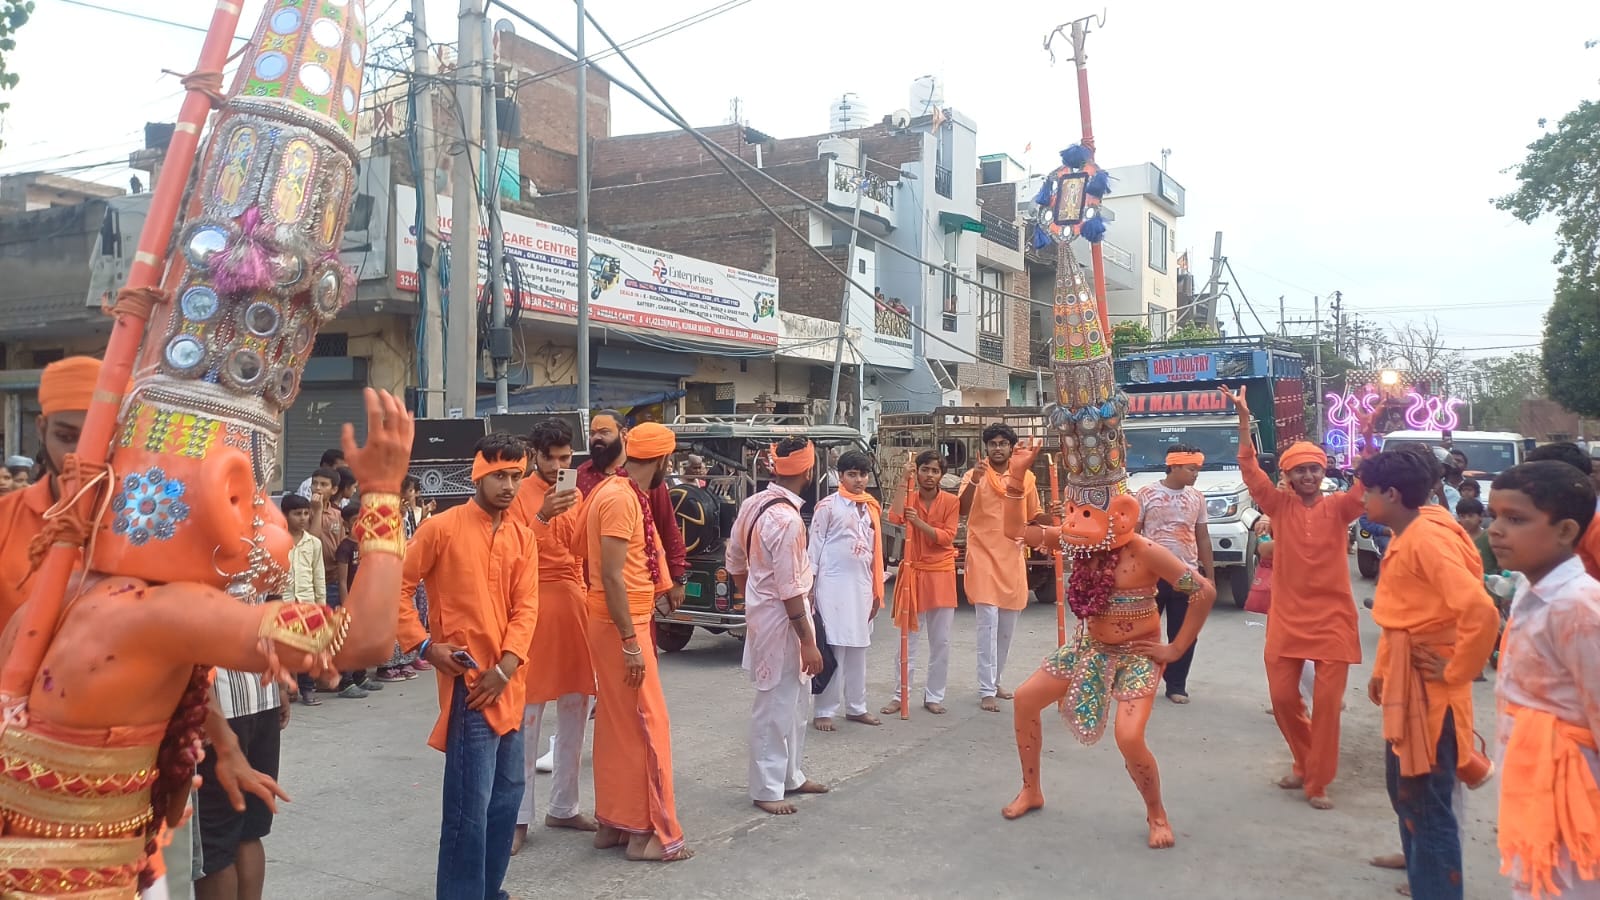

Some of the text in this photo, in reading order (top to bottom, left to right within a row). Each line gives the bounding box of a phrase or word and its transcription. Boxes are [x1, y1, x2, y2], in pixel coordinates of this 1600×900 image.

[503, 231, 533, 248] CARE
[537, 239, 577, 257] CENTRE
[527, 252, 547, 261] OKAYA
[536, 264, 552, 272] Spare
[669, 266, 714, 285] Enterprises
[545, 285, 566, 295] Battery
[1153, 355, 1209, 374] BABU POULTRY
[1128, 392, 1227, 413] AI MAA KALI
